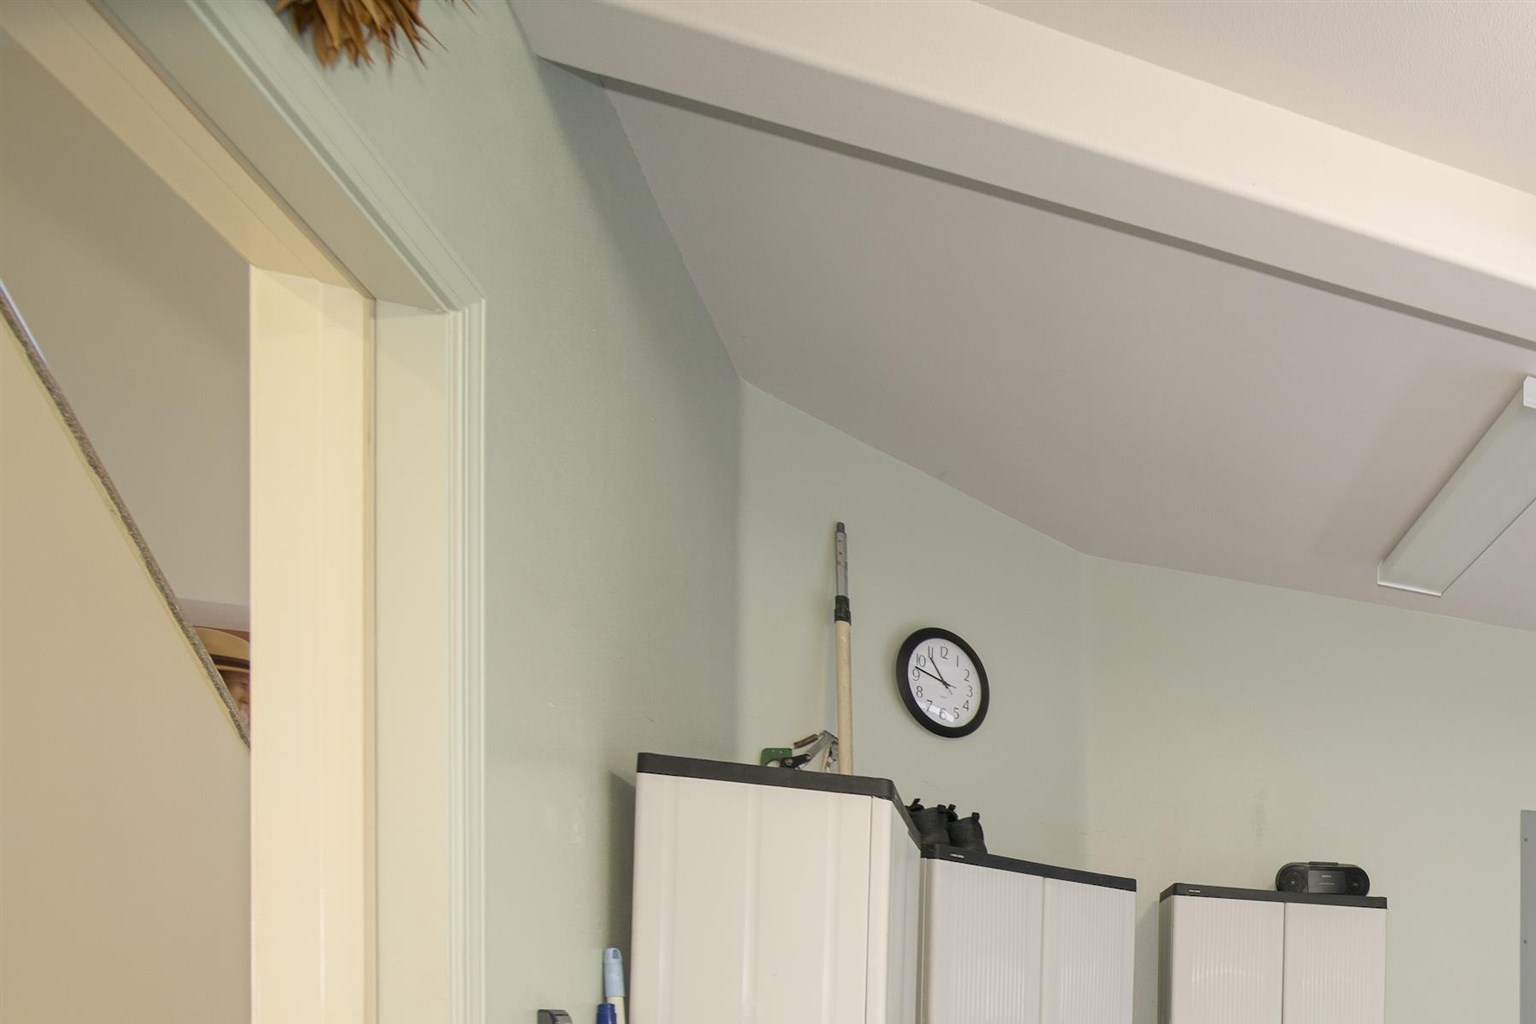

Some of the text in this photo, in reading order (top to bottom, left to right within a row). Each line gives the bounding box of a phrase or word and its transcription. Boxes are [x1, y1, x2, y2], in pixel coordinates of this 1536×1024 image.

[940, 645, 949, 660] 12
[916, 654, 926, 668] 10
[912, 669, 920, 681] 9
[964, 668, 971, 682] 2
[916, 685, 924, 699] 8
[966, 685, 974, 698] 3
[926, 699, 933, 712] 7
[962, 699, 970, 711] 4
[939, 708, 947, 720] 6
[953, 707, 960, 720] 5
